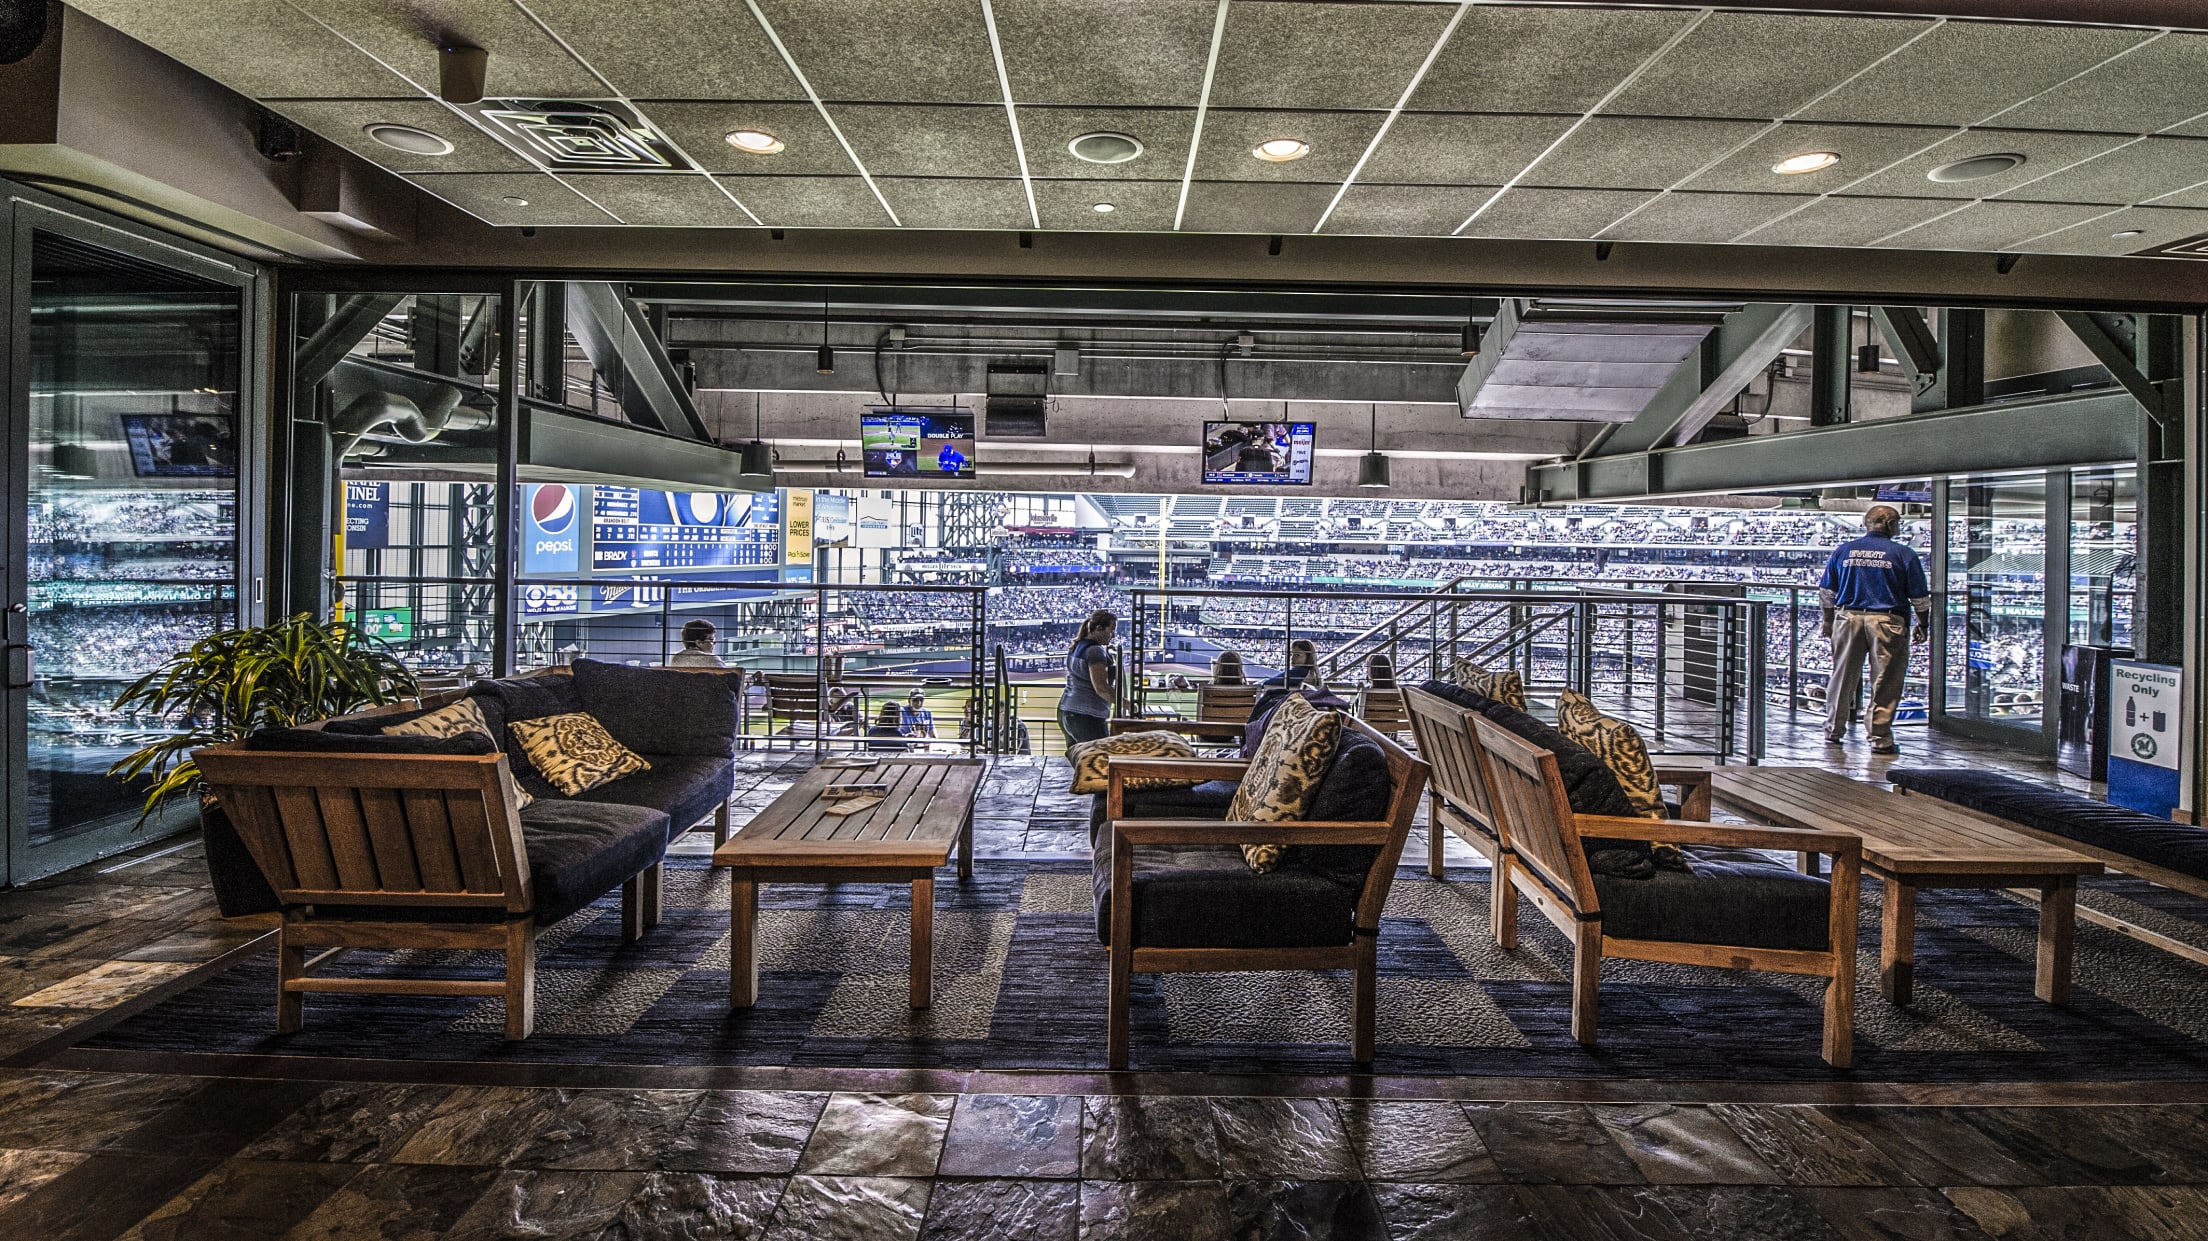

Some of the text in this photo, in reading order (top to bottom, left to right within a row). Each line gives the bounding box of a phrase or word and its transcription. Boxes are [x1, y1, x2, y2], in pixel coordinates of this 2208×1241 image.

[789, 521, 809, 529] LOWER
[789, 529, 810, 537] PRICES
[536, 538, 573, 555] pepsi
[603, 551, 628, 561] BRADY
[1849, 550, 1886, 558] EVENT
[2116, 668, 2177, 688] Recycling
[2061, 682, 2080, 693] WASTE
[2131, 684, 2160, 698] Only
